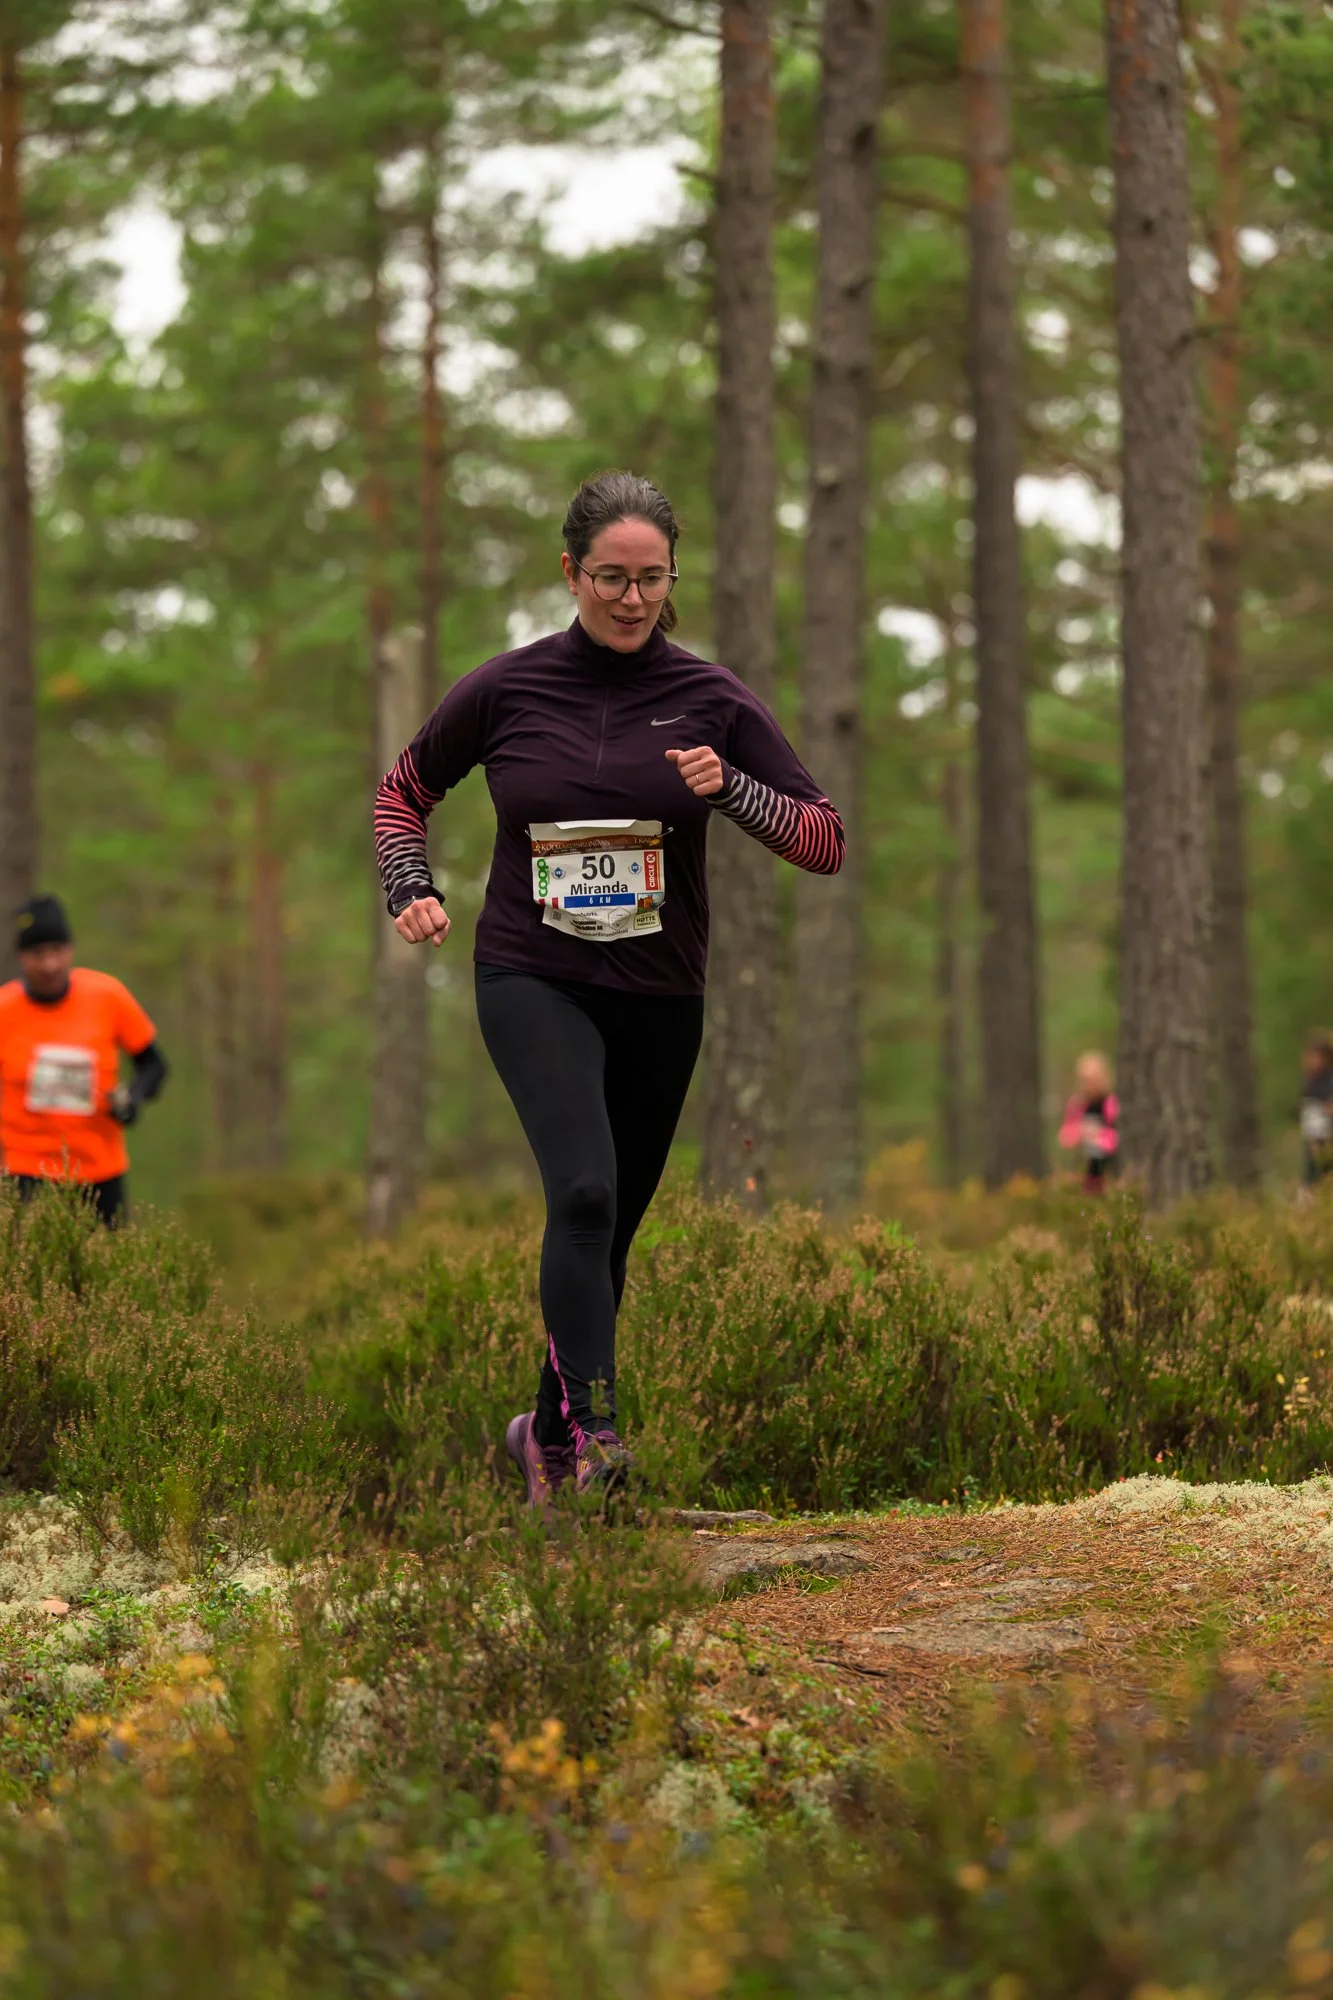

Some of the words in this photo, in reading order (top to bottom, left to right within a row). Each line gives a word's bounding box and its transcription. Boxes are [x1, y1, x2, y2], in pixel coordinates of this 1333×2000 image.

[537, 858, 549, 897] coop
[581, 854, 615, 880] 50
[648, 865, 656, 888] CIRCLE
[570, 881, 628, 896] Miranda
